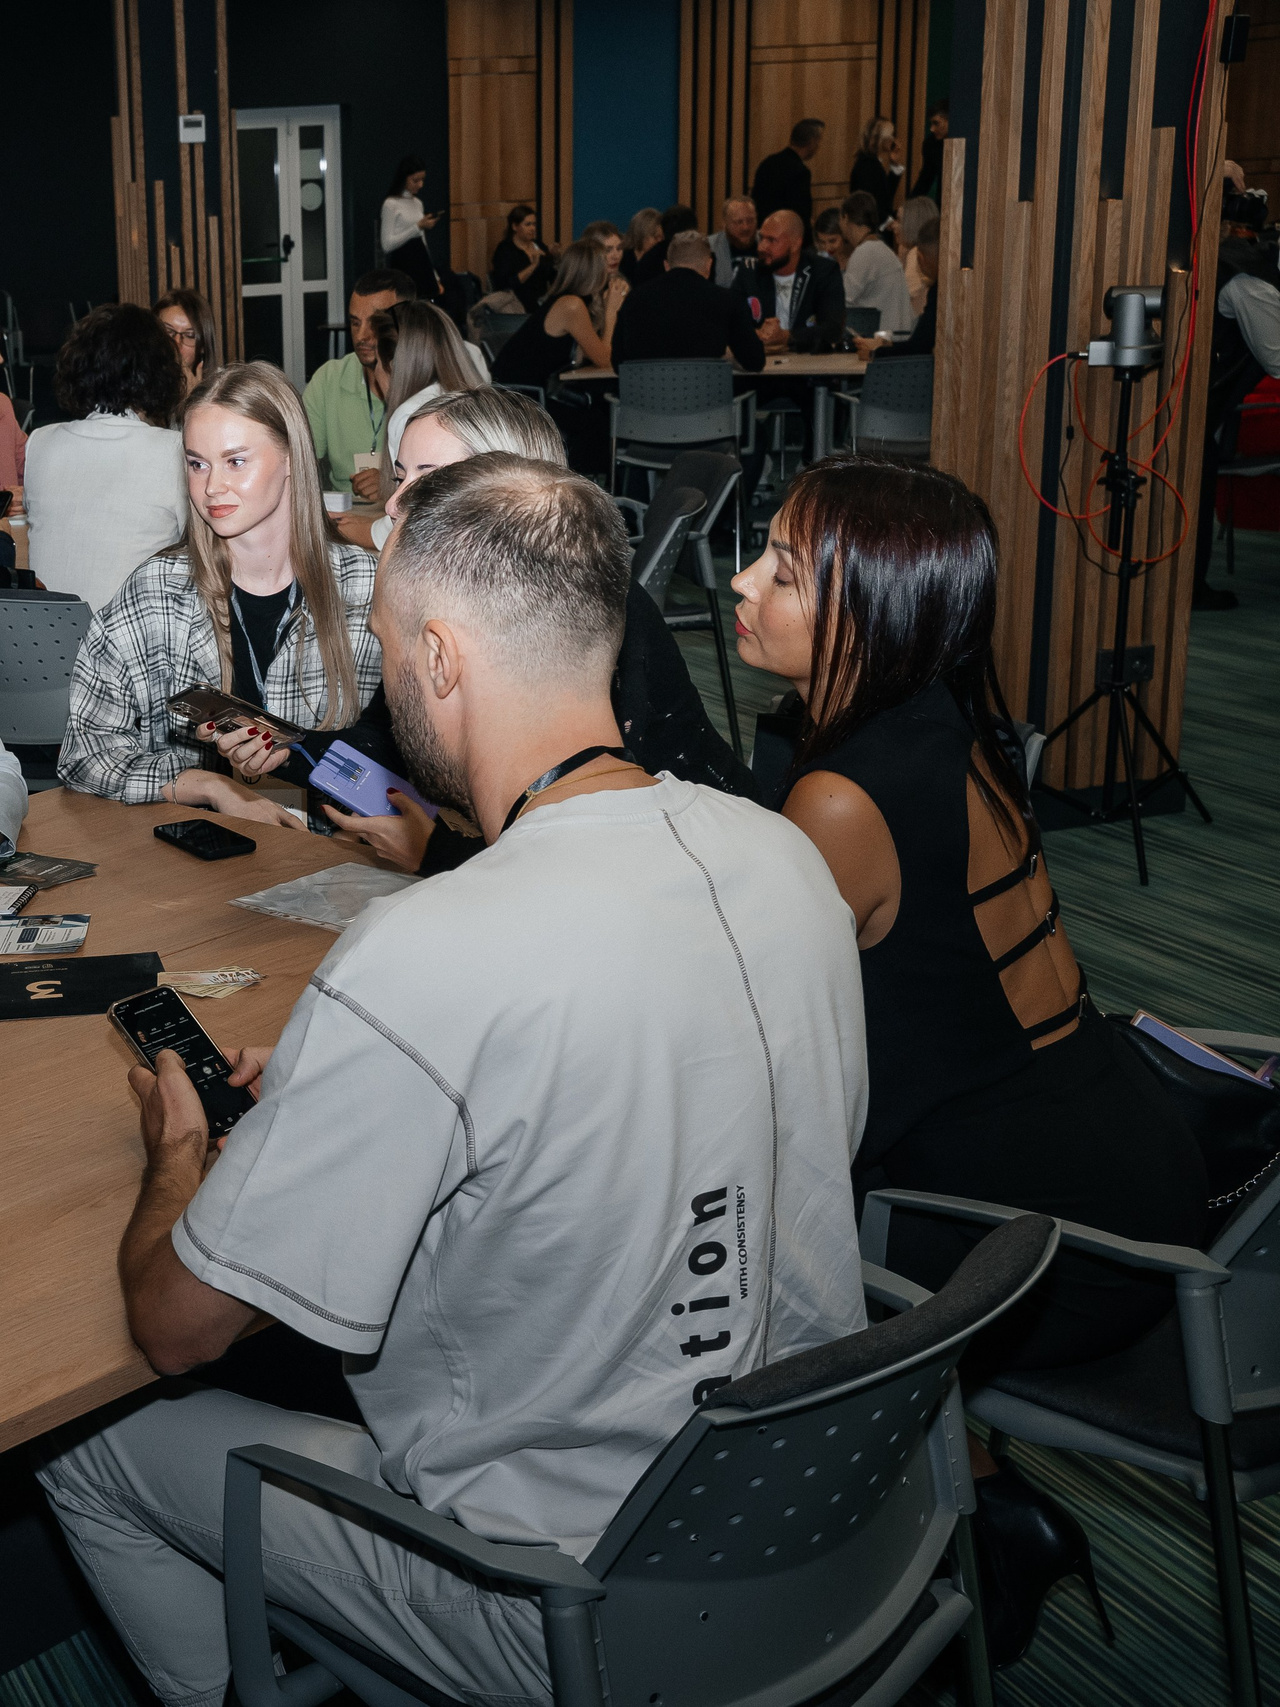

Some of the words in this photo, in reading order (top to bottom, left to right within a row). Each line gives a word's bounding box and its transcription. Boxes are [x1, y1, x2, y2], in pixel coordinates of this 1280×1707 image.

[25, 980, 64, 1000] 3
[736, 1184, 748, 1266] CONSISTENSY
[740, 1267, 748, 1299] WITH
